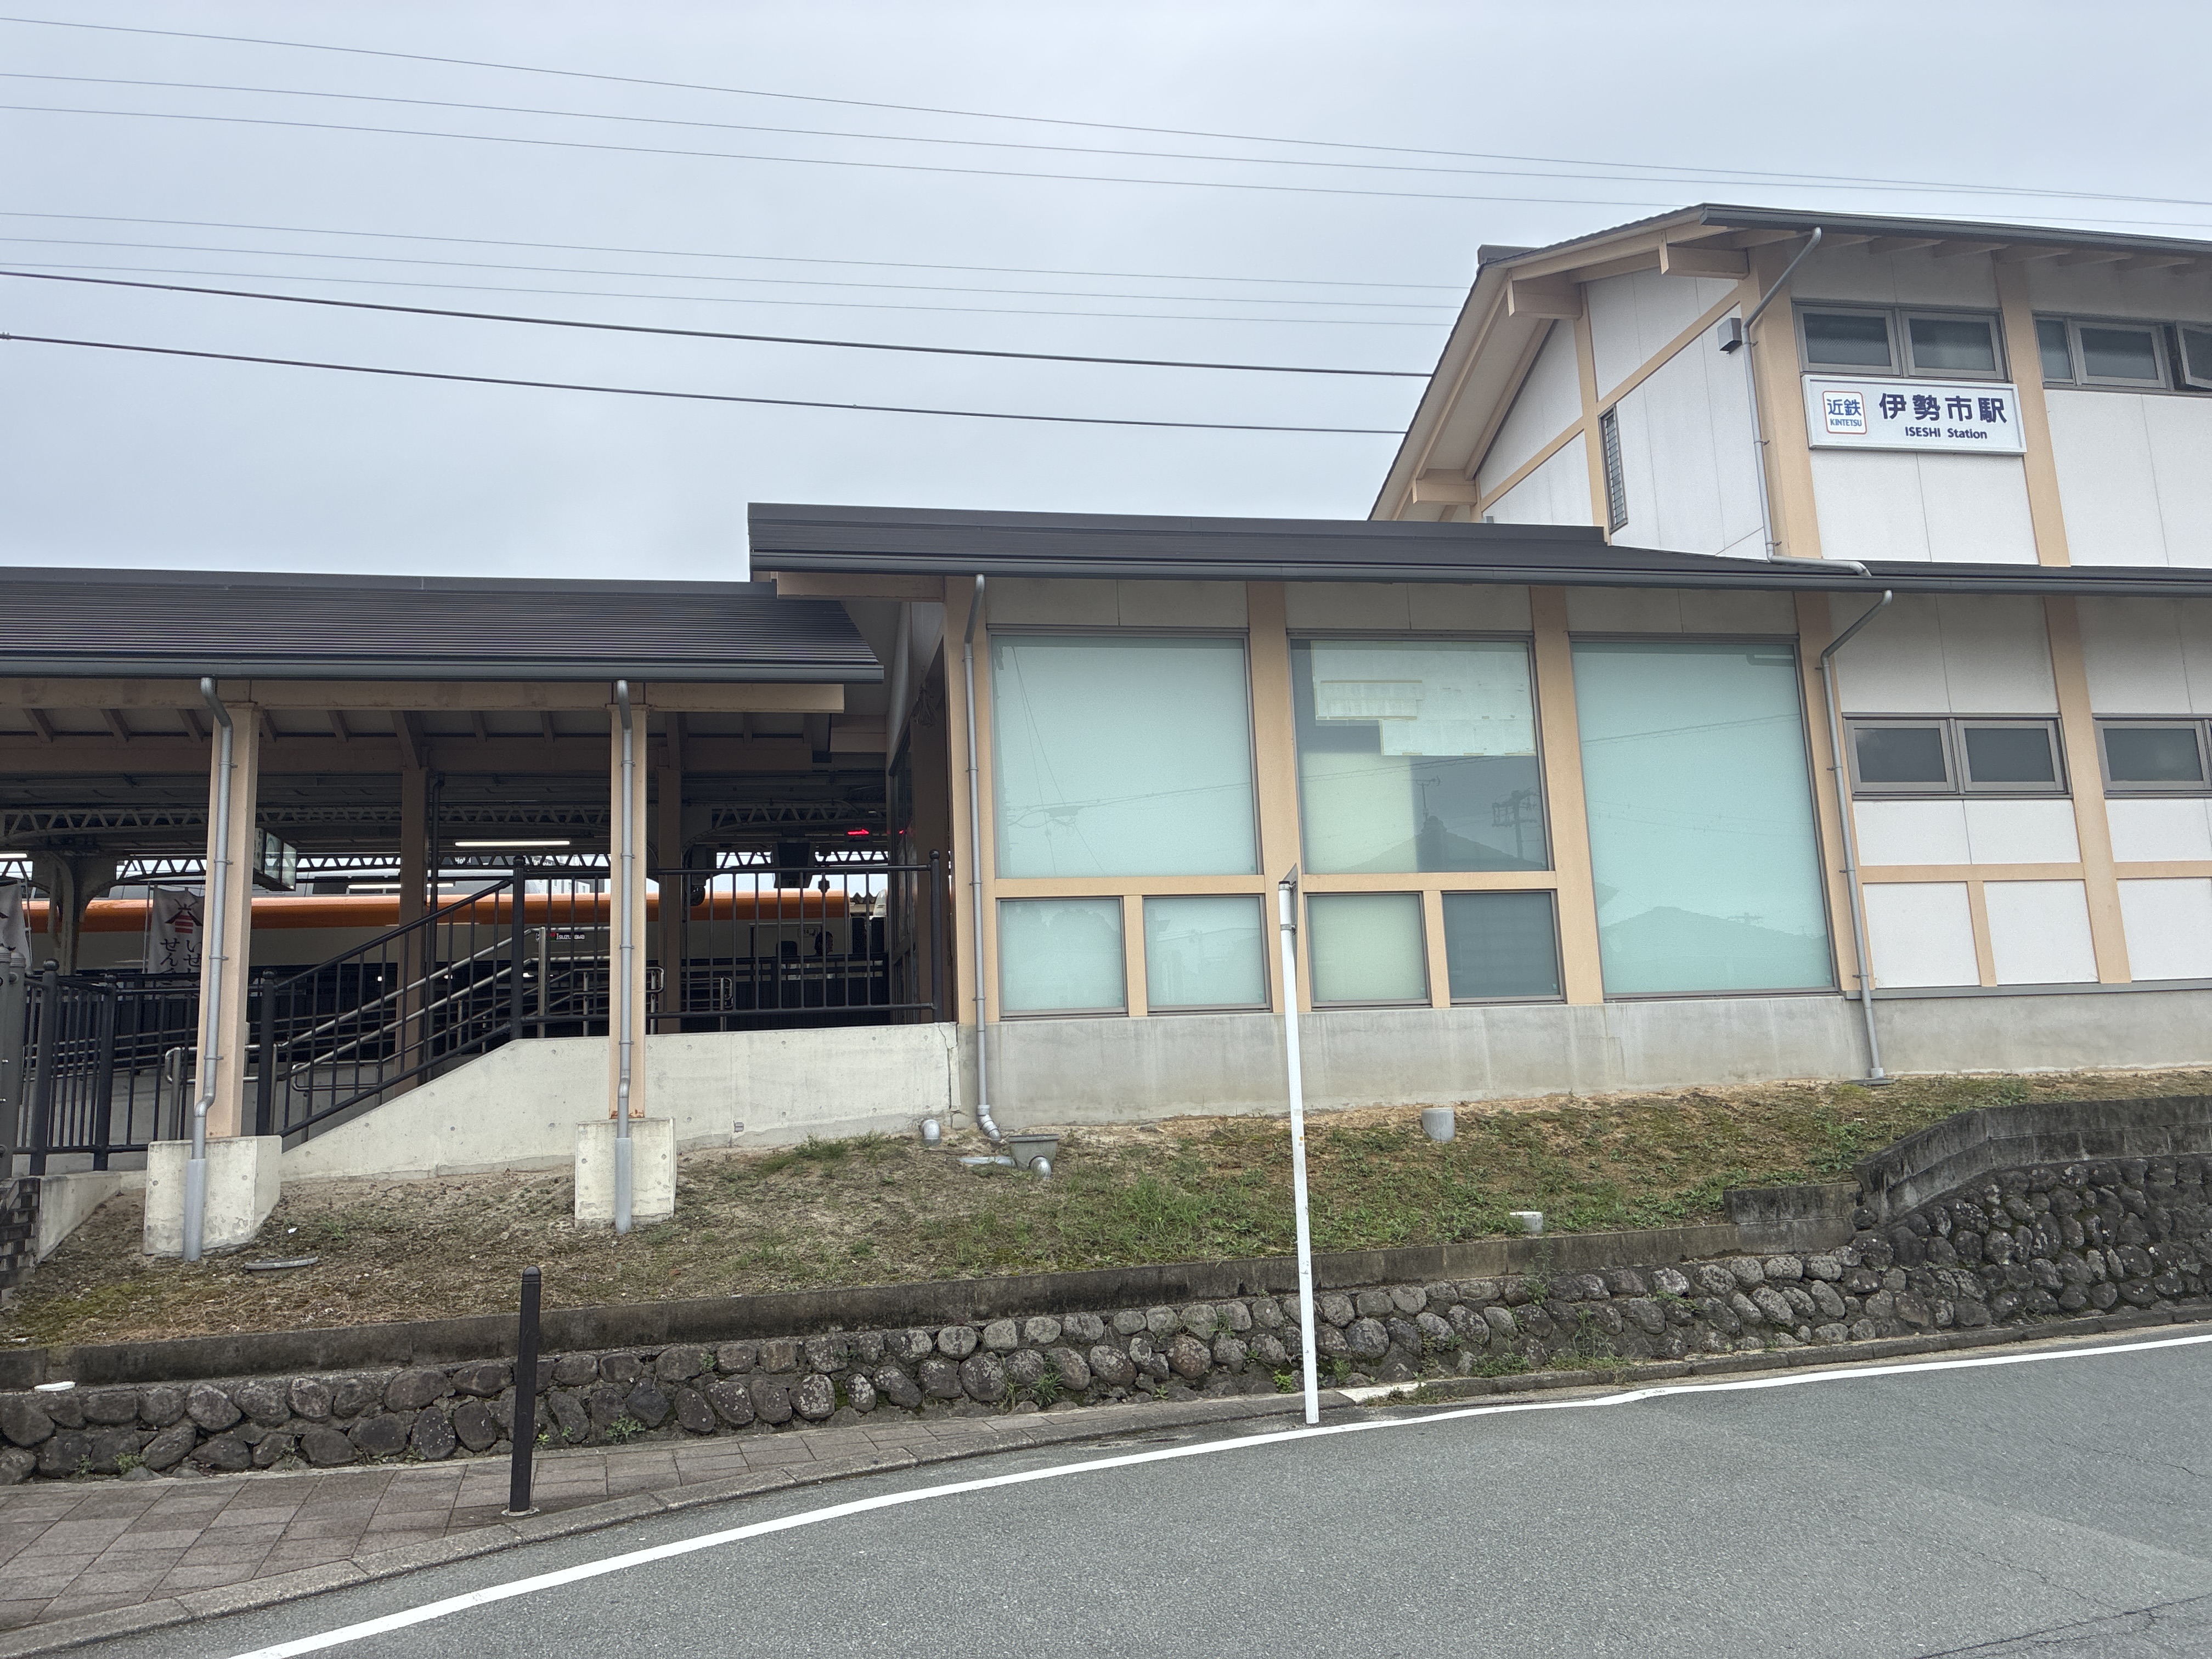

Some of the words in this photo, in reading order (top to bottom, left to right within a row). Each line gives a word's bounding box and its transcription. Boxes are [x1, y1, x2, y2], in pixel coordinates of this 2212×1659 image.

[1826, 398, 1862, 416] 近鉄
[1878, 392, 2007, 424] 伊勢市駅
[1830, 418, 1863, 427] KINTETSU
[1905, 426, 1941, 437] ISESHI
[1947, 427, 1988, 439] Station
